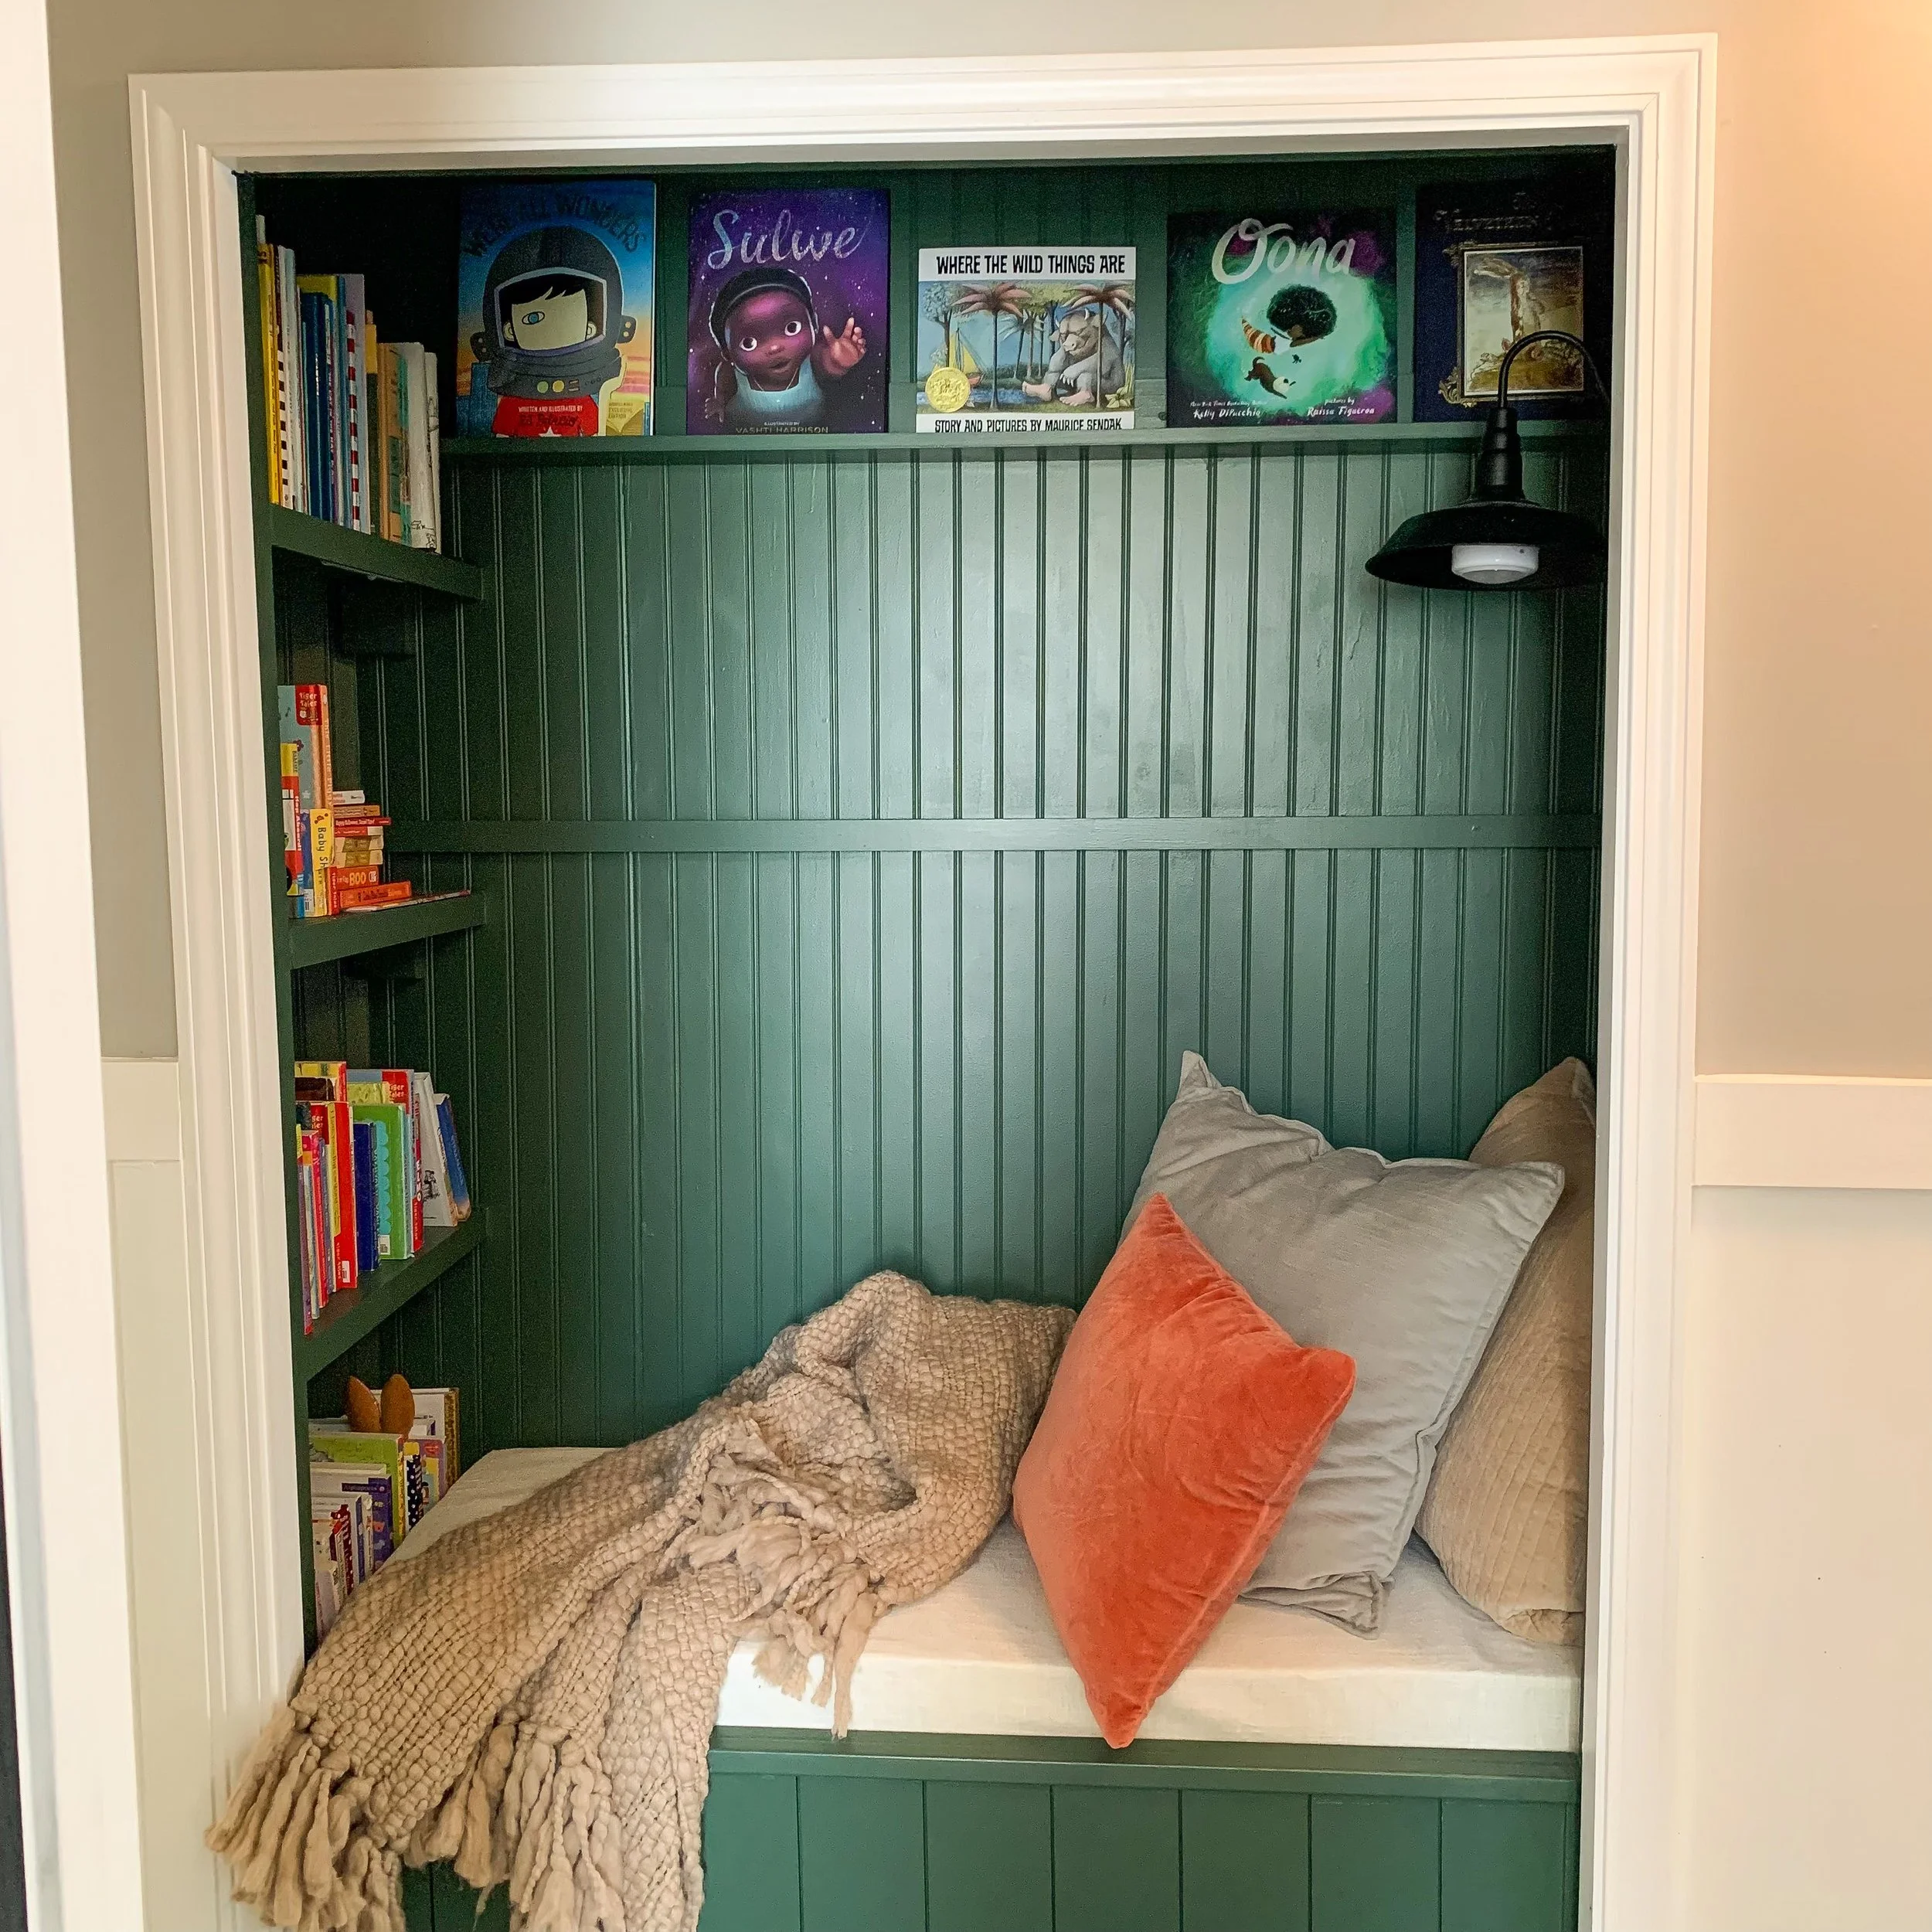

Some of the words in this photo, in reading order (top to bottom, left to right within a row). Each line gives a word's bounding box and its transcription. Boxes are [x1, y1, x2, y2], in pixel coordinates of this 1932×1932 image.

[707, 209, 865, 270] Sulwe
[1212, 218, 1355, 285] Oona
[936, 255, 981, 274] WHERE
[984, 255, 1008, 274] THE
[1012, 255, 1043, 274] WILD
[1048, 255, 1095, 274] THINGS
[1100, 255, 1126, 274] ARE
[1347, 396, 1355, 405] by
[1193, 408, 1216, 420] Kelly
[1338, 406, 1375, 417] Figueroa
[935, 420, 962, 433] STORY
[964, 420, 983, 433] AND
[987, 419, 1027, 432] PICTURES
[1030, 419, 1042, 432] BY
[1045, 418, 1083, 431] MAURICE
[1087, 418, 1121, 430] SENDAK
[316, 826, 328, 852] Baby
[349, 872, 366, 886] BOO
